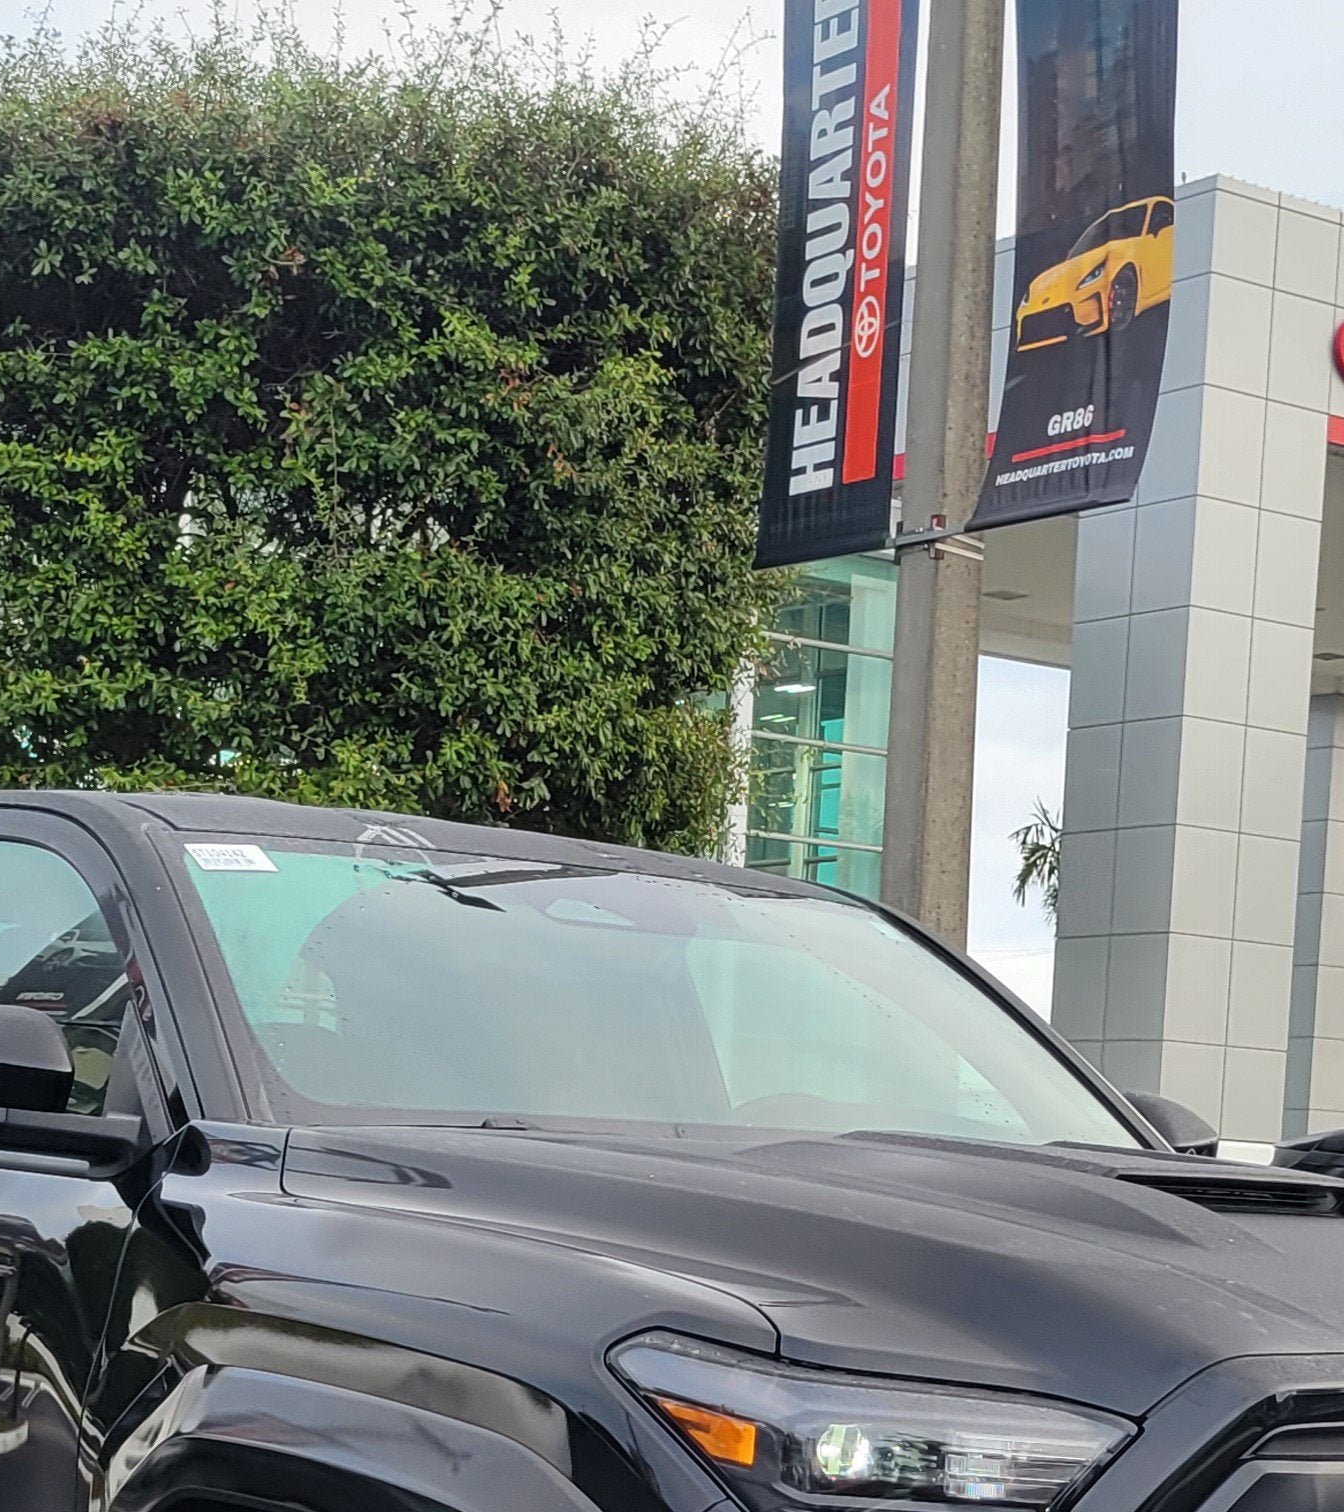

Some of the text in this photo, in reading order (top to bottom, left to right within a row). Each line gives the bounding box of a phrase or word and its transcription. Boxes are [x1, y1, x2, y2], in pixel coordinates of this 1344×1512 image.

[860, 84, 891, 292] TOYOTA
[1047, 404, 1095, 437] GR86
[995, 445, 1135, 486] HEADQUARTERTOYOTA.COM
